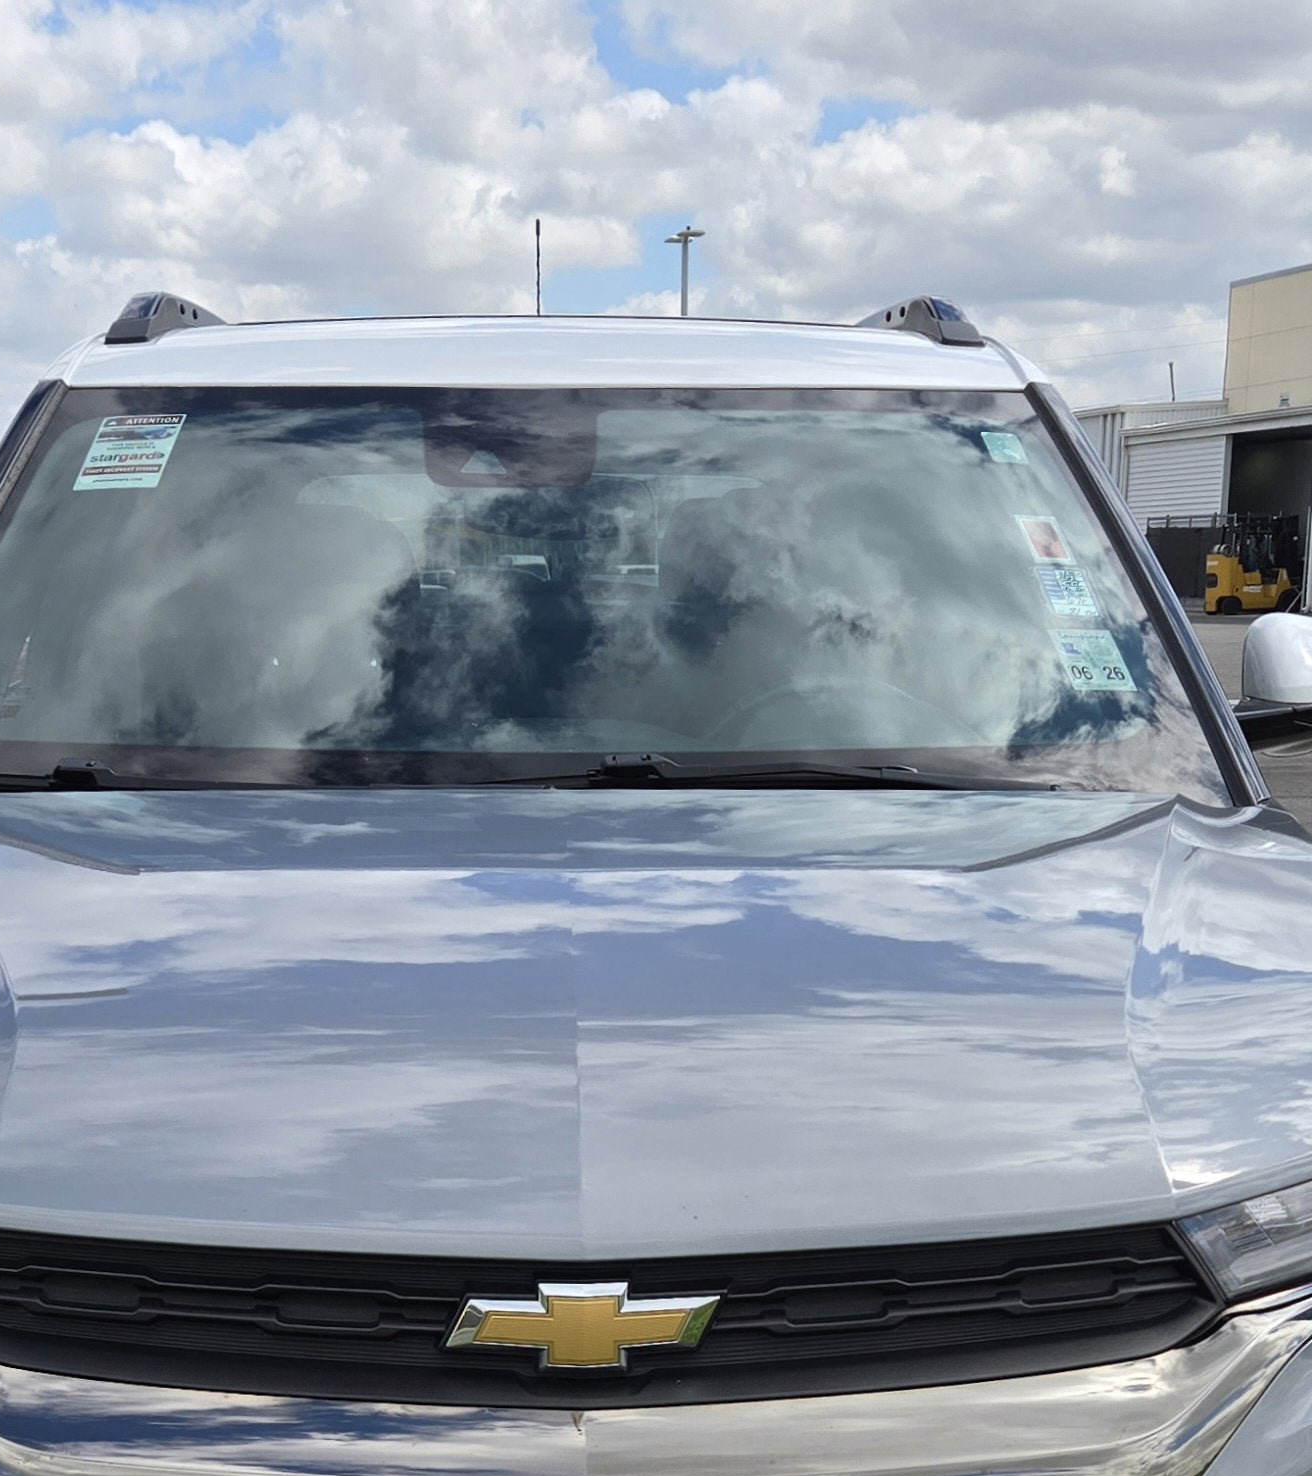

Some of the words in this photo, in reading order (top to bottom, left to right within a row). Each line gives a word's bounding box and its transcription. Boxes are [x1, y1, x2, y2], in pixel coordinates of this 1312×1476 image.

[126, 417, 179, 425] ATTENTION
[1071, 665, 1093, 680] 06
[1103, 666, 1125, 680] 26
